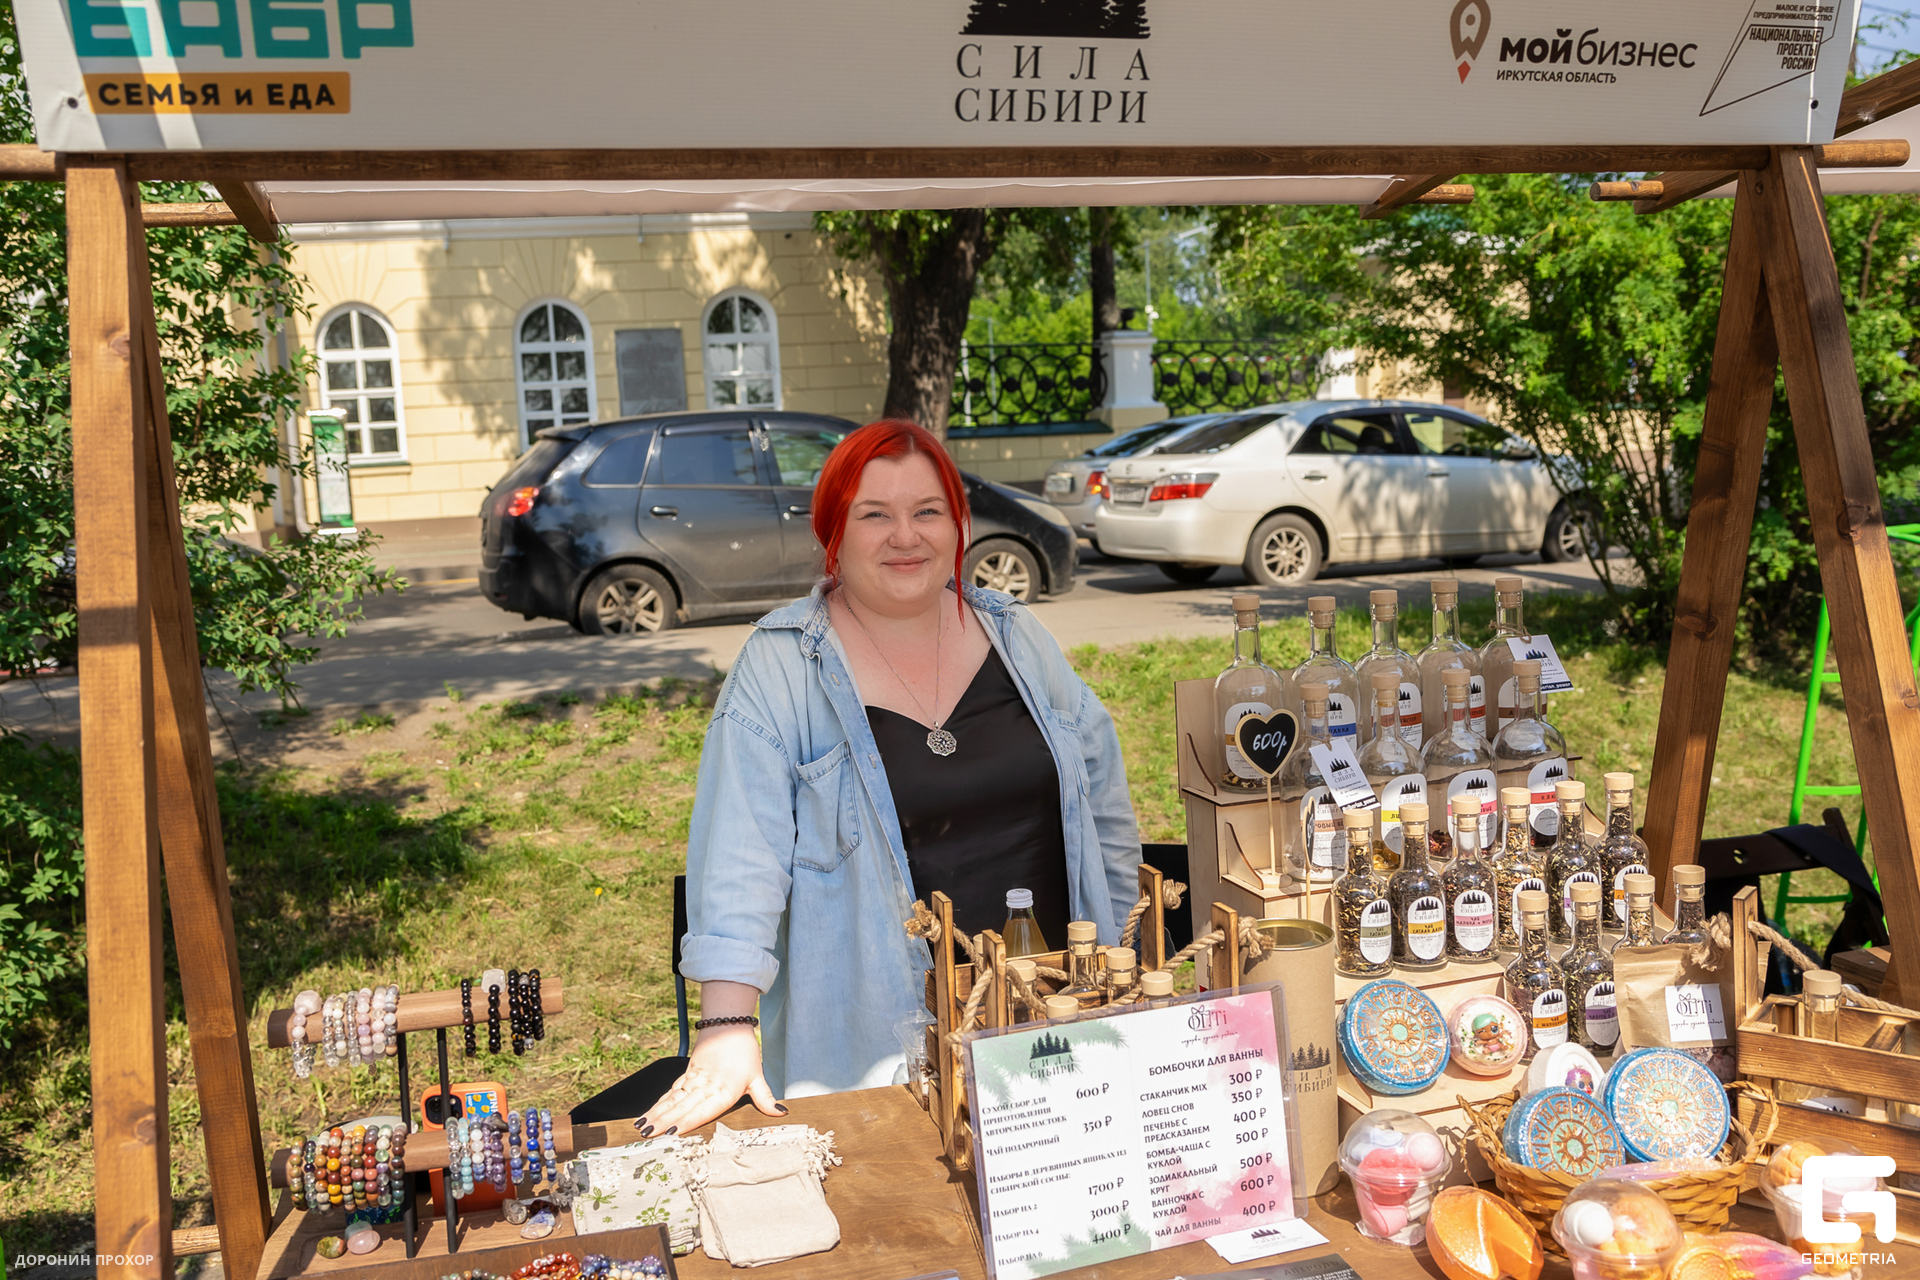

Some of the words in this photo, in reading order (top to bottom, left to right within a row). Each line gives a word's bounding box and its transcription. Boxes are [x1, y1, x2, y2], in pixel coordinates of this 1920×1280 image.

[1776, 4, 1798, 12] МАЛОЕ
[1805, 5, 1834, 13] СРЕДНЕЕ
[1753, 12, 1833, 21] ПРЕДПРИНИМАТЕЛЬСТВО
[1749, 27, 1820, 43] НАЦИОНАЛЬНЫЕ
[1777, 43, 1818, 56] ПРОЕКТЫ
[1781, 57, 1815, 70] РОССИИ
[1496, 69, 1563, 83] ИРКУТСКАЯ
[1565, 72, 1617, 84] ОБЛАСТЬ
[98, 82, 220, 107] СЕМЬЯ
[234, 88, 254, 107] и
[266, 82, 336, 110] ЕДА
[955, 87, 1148, 123] СИБИРИ
[1149, 1058, 1205, 1076] БОМБОЧКИ
[1207, 1055, 1226, 1067] ДЛЯ
[1229, 1048, 1263, 1062] ВАННЫ
[1030, 1063, 1075, 1080] СИБИРИ
[1229, 1071, 1252, 1085] 300
[1076, 1086, 1099, 1100] 600
[1140, 1086, 1190, 1102] СТАКАНЧИК
[1231, 1090, 1252, 1104] 350
[982, 1101, 1009, 1115] СУХОЙ
[1010, 1099, 1030, 1110] СБОР
[1031, 1096, 1047, 1106] ДЛЯ
[1142, 1107, 1170, 1119] ЛОВЕЦ
[1171, 1102, 1195, 1114] СНОВ
[983, 1107, 1051, 1126] ПРИГОТОВЛЕНИЯ
[1233, 1109, 1256, 1123] 400
[984, 1122, 1031, 1138] АВТОРСКИХ
[1032, 1115, 1067, 1128] НАСТОЕК
[1082, 1119, 1102, 1134] 350
[1143, 1119, 1181, 1133] ПЕЧЕНЬЕ
[1144, 1125, 1210, 1144] ПРЕДСКАЗАНЕМ
[1235, 1130, 1258, 1144] 500
[986, 1145, 1003, 1156] ЧАЙ
[1005, 1135, 1060, 1154] ПОДАРОЧНЫЙ
[1146, 1142, 1204, 1159] БОМБА-ЧАША
[989, 1171, 1023, 1184] НАБОРЫ
[1024, 1169, 1030, 1177] В
[1031, 1158, 1082, 1176] ДЕРЕВЯННЫХ
[1082, 1151, 1115, 1165] ЯЩИКАХ
[1116, 1149, 1127, 1157] ИЗ
[1147, 1156, 1182, 1170] КУКЛОЙ
[1240, 1155, 1263, 1169] 500
[1149, 1163, 1218, 1185] ЗОДИАКАЛЬНЫЙ
[990, 1177, 1039, 1195] СИБИРСКОЙ
[1040, 1173, 1071, 1185] СОСНЫ:
[1088, 1181, 1114, 1196] 1700
[1150, 1184, 1170, 1196] КРУГ
[1240, 1177, 1264, 1192] 600
[1152, 1192, 1198, 1208] ВАННОЧКА
[993, 1207, 1020, 1218] НАБОР
[1021, 1204, 1032, 1212] НА
[1090, 1205, 1119, 1221] 3000
[1153, 1204, 1188, 1219] КУКЛОЙ
[1242, 1203, 1266, 1217] 400
[1155, 1225, 1173, 1238] ЧАЙ
[1173, 1223, 1190, 1235] ДЛЯ
[1192, 1217, 1221, 1230] ВАННЫ
[995, 1231, 1021, 1243] НАБОР
[1023, 1229, 1034, 1237] НА
[1092, 1228, 1121, 1245] 4400
[998, 1254, 1025, 1266] НАБОР
[1026, 1252, 1037, 1260] НА
